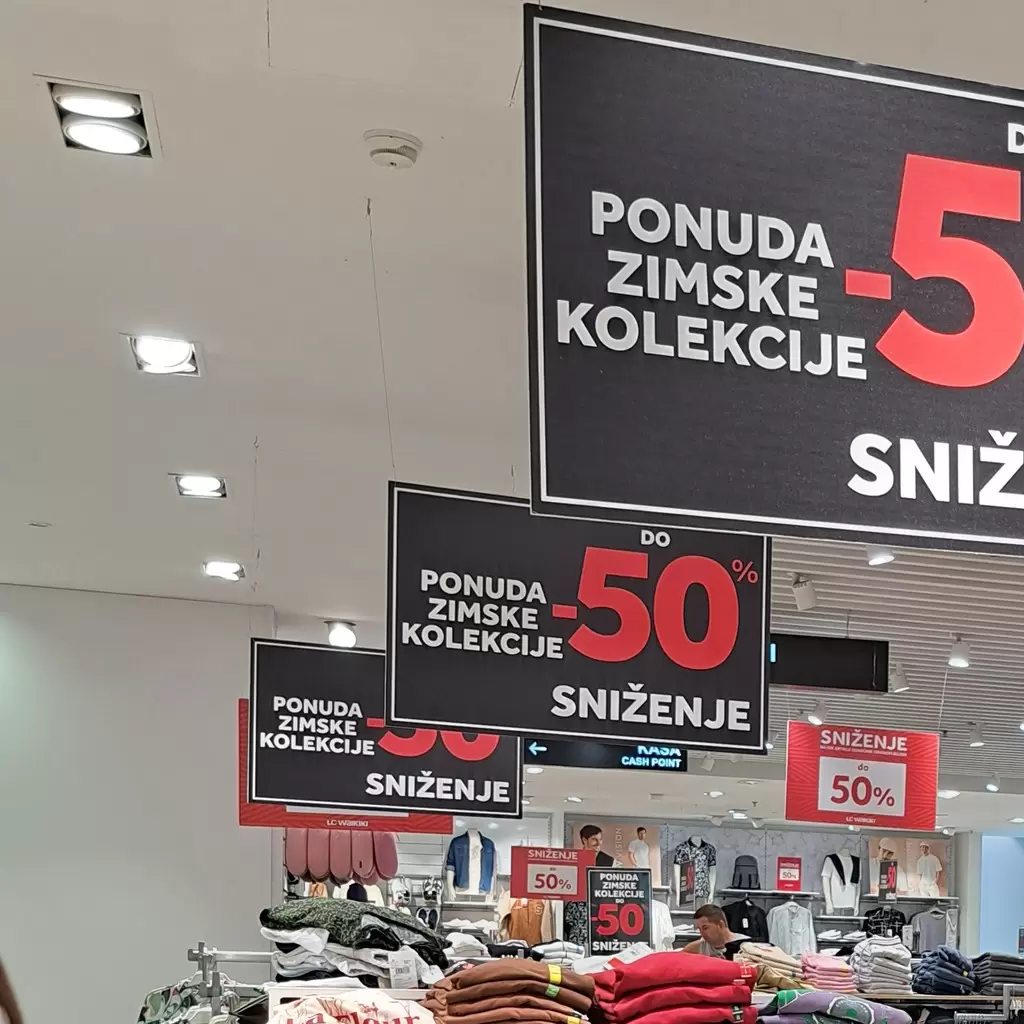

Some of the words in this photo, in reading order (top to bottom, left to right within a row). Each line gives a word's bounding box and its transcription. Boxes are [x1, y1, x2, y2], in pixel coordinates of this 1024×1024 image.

[592, 191, 834, 268] PONUDA
[607, 251, 819, 320] ZIMSKE
[557, 300, 867, 380] KOLEKCIJE
[640, 530, 671, 548] DO
[421, 569, 546, 604] PONUDA
[428, 599, 538, 630] ZIMSKE
[402, 623, 563, 660] KOLEKCIJE
[273, 696, 363, 718] PONUDA
[550, 683, 751, 732] SNIŽENJE
[278, 715, 357, 736] ZIMSKE
[260, 732, 375, 755] KOLEKCIJE
[820, 729, 907, 751] SNIŽENJE
[621, 756, 649, 766] CASH
[651, 758, 682, 767] POINT
[858, 763, 869, 771] do
[365, 771, 510, 802] SNIŽENJE
[830, 775, 895, 807] 50%
[327, 818, 337, 826] LC
[528, 848, 578, 860] SNIŽENJE
[534, 874, 572, 890] 50%
[600, 873, 639, 882] PONUDA
[602, 882, 637, 890] ZIMSKE
[594, 890, 645, 898] KOLEKCIJE
